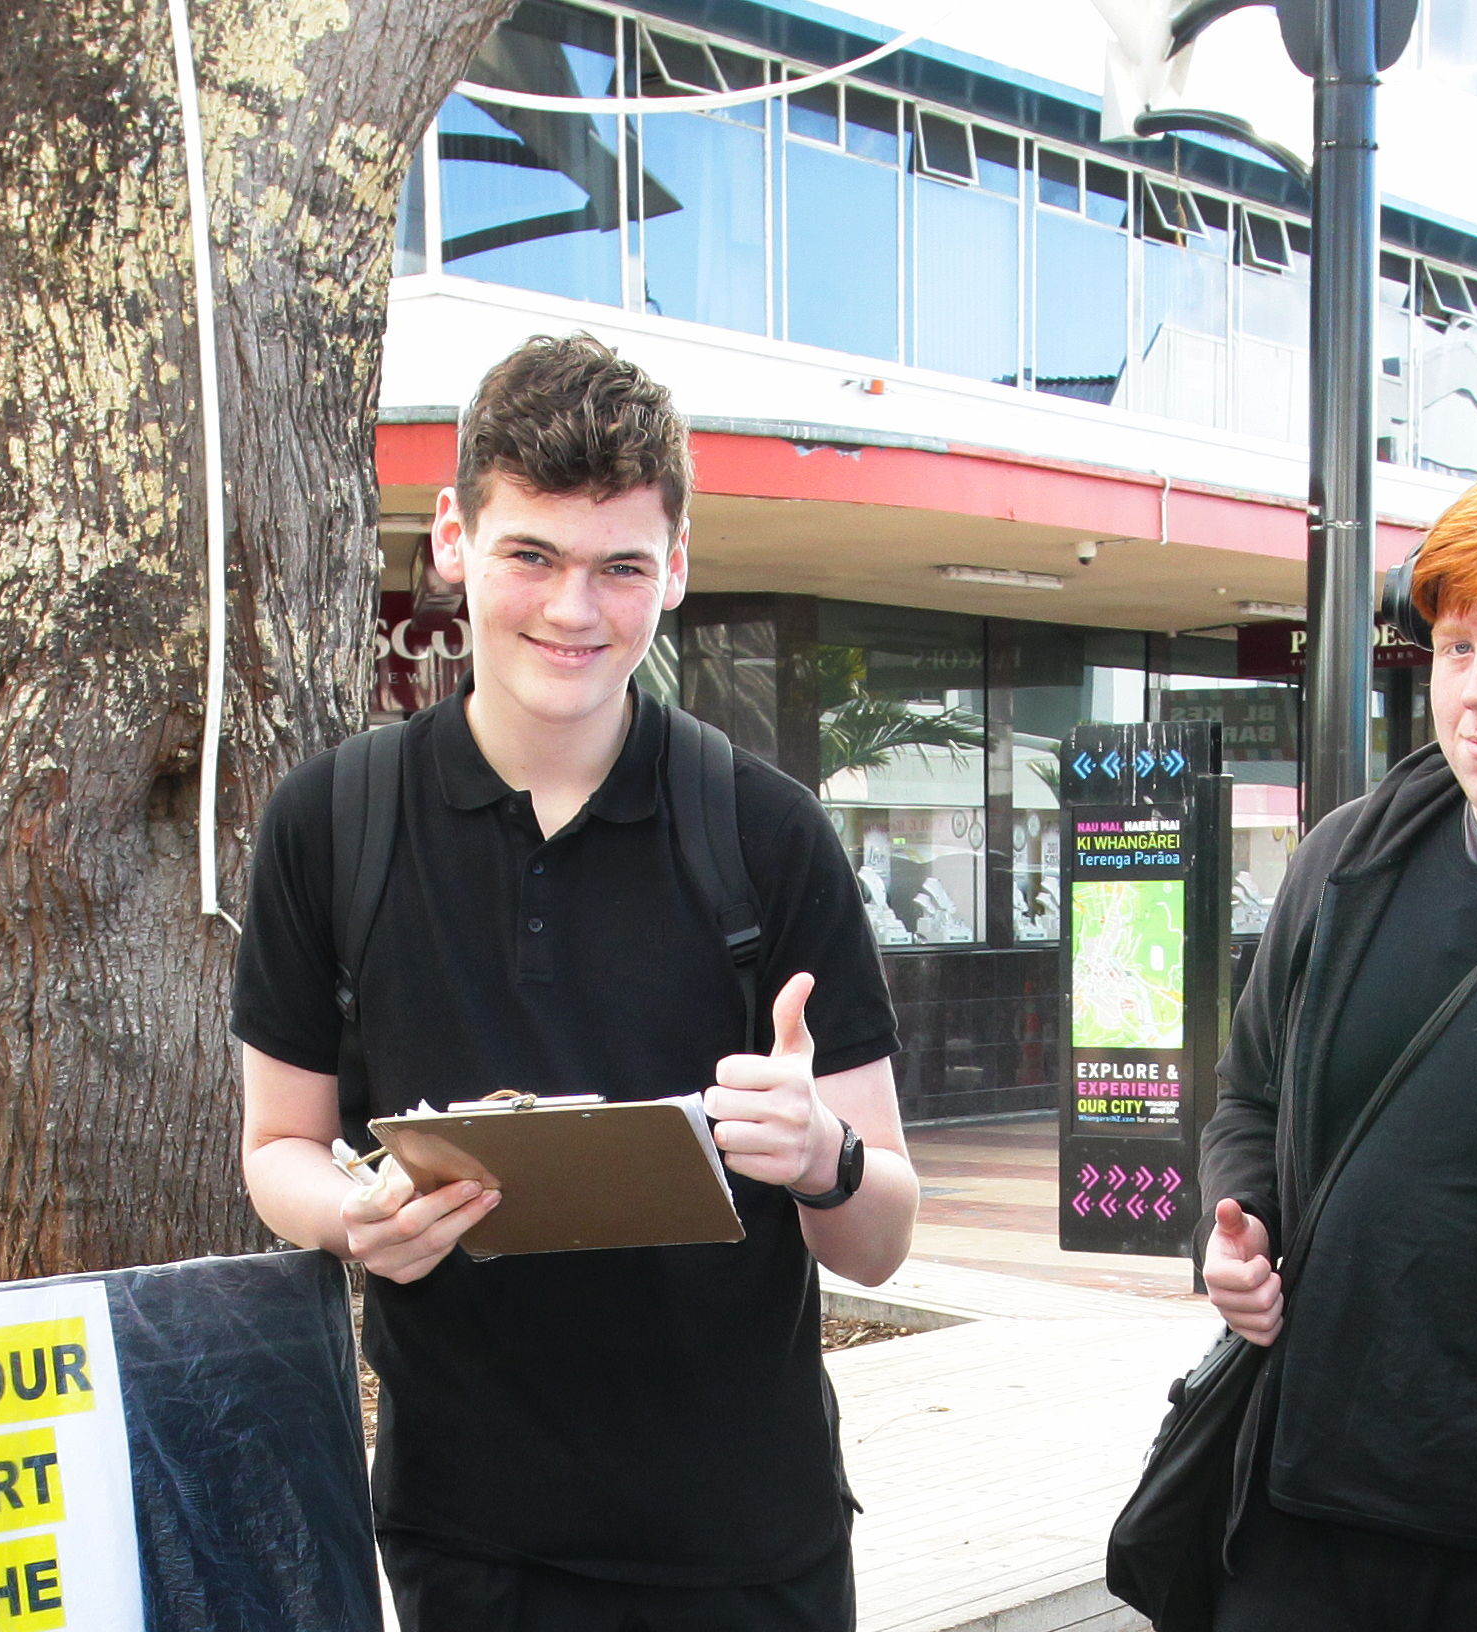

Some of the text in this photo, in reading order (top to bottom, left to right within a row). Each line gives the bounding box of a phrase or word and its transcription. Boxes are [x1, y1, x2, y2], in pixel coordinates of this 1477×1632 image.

[1077, 832, 1180, 850] KI WHANGĀREI
[1077, 852, 1131, 869] Terenga
[1134, 850, 1180, 865] Parāoa
[1077, 1062, 1179, 1080] EXPLORE &
[1078, 1081, 1180, 1098] EXPERIENCE
[1077, 1099, 1108, 1113] OUR
[1110, 1099, 1143, 1114] CITY
